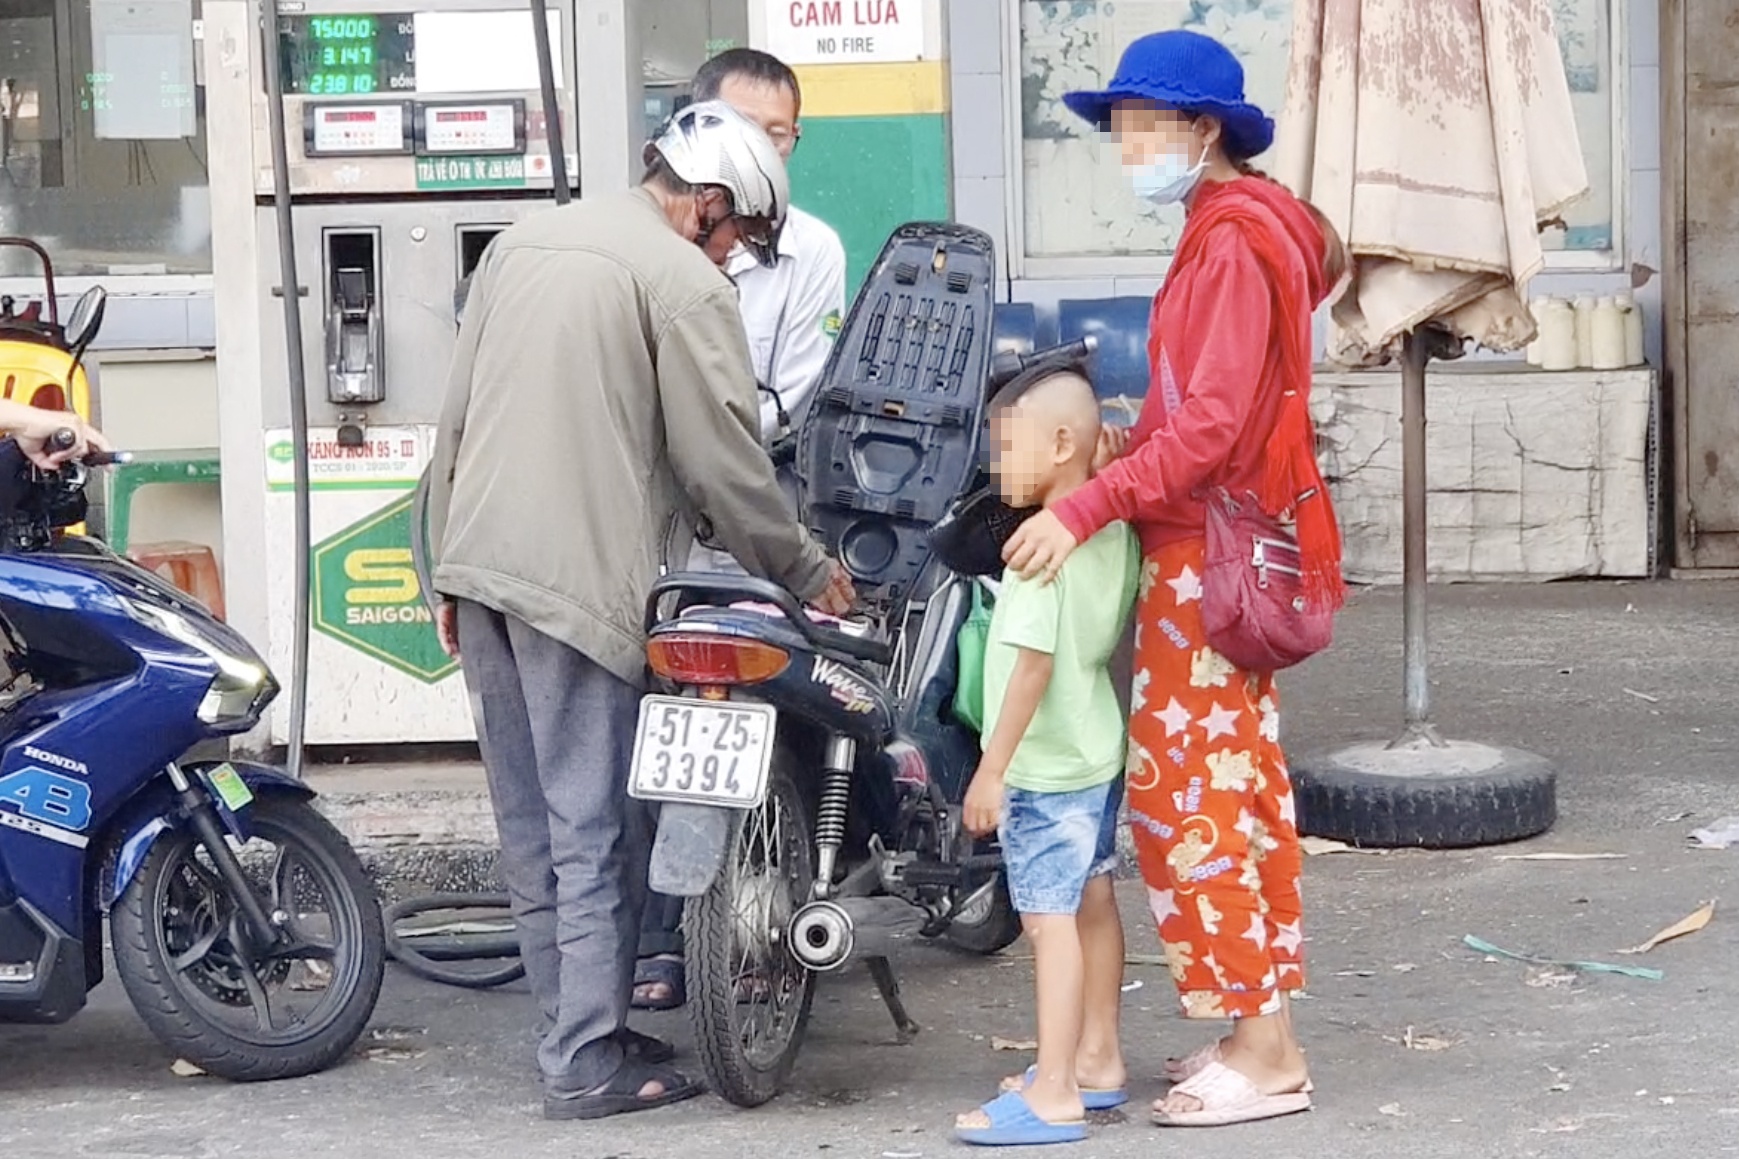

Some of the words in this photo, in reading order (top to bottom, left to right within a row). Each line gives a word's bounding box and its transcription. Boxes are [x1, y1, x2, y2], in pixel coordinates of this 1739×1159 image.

[817, 38, 836, 54] NO
[843, 37, 874, 53] FIRE
[377, 440, 390, 458] 95
[345, 606, 432, 624] SAIGON
[811, 654, 873, 700] Wave
[23, 746, 89, 775] HONDA
[652, 751, 740, 794] 3394
